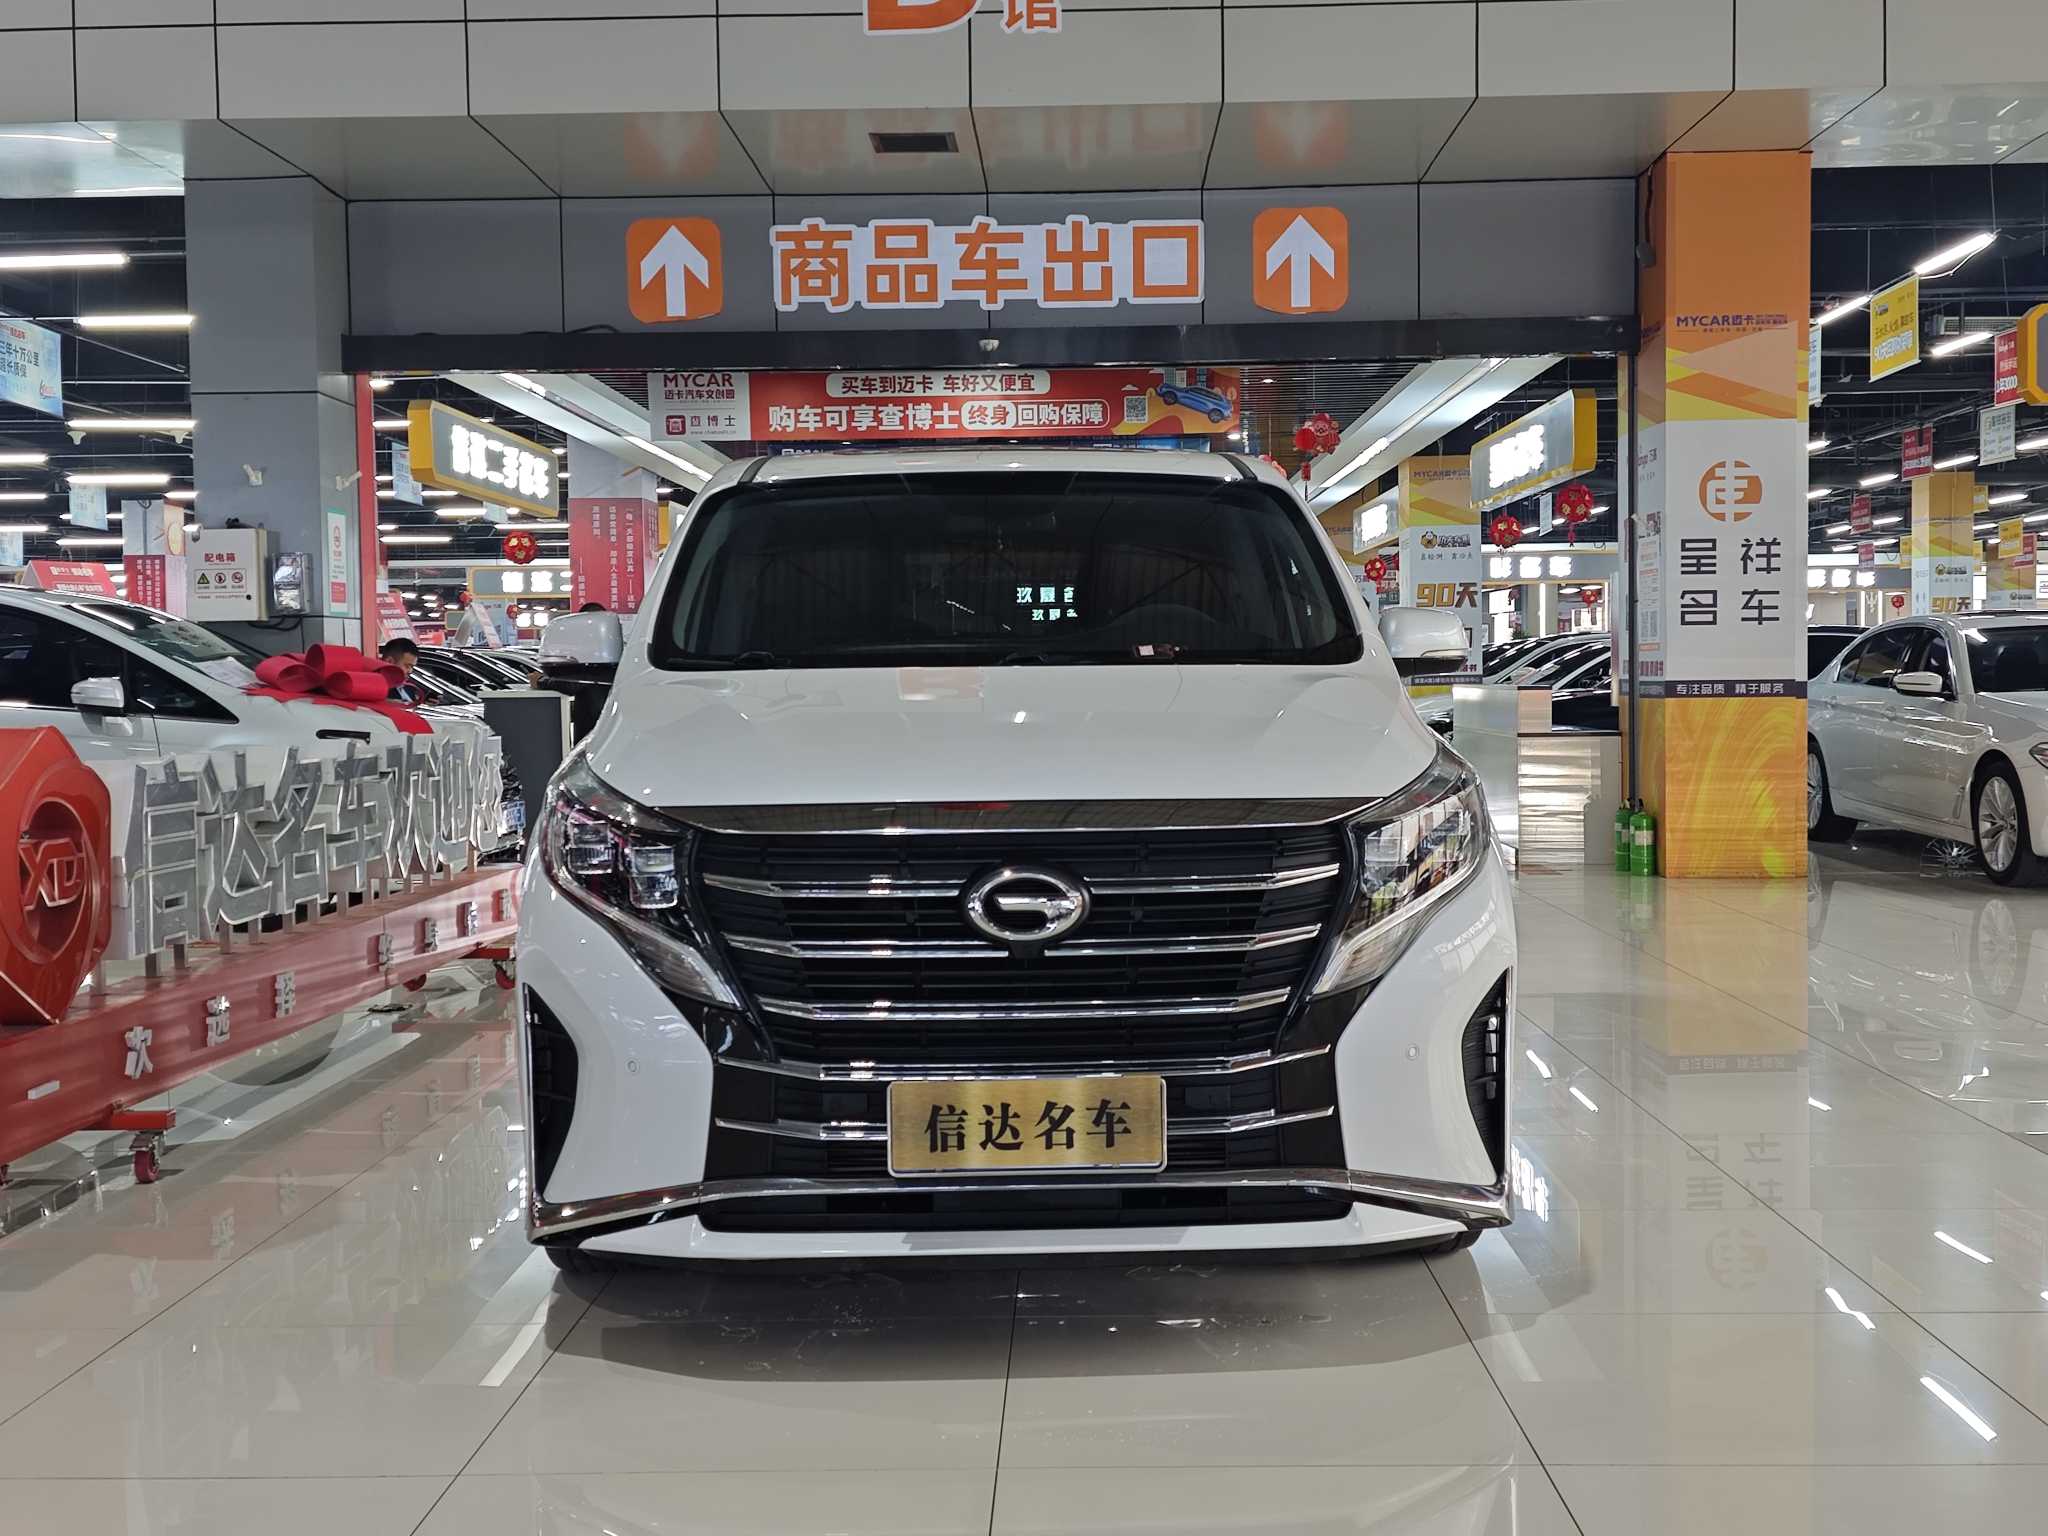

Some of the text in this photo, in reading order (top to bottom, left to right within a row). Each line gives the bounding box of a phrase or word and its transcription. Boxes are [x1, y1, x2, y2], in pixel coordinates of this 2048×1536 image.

[775, 220, 1200, 307] 商品车出口
[663, 373, 733, 388] MYCAR
[841, 373, 1035, 395] 买车到迈卡 车好又便宜
[204, 552, 236, 562] 配电箱
[1680, 537, 1781, 575] 呈祥
[1415, 582, 1479, 608] 90天
[1680, 588, 1781, 626] 名车
[1676, 682, 1784, 695] 专注品质 精于服务
[924, 1098, 1133, 1153] 信达名车
